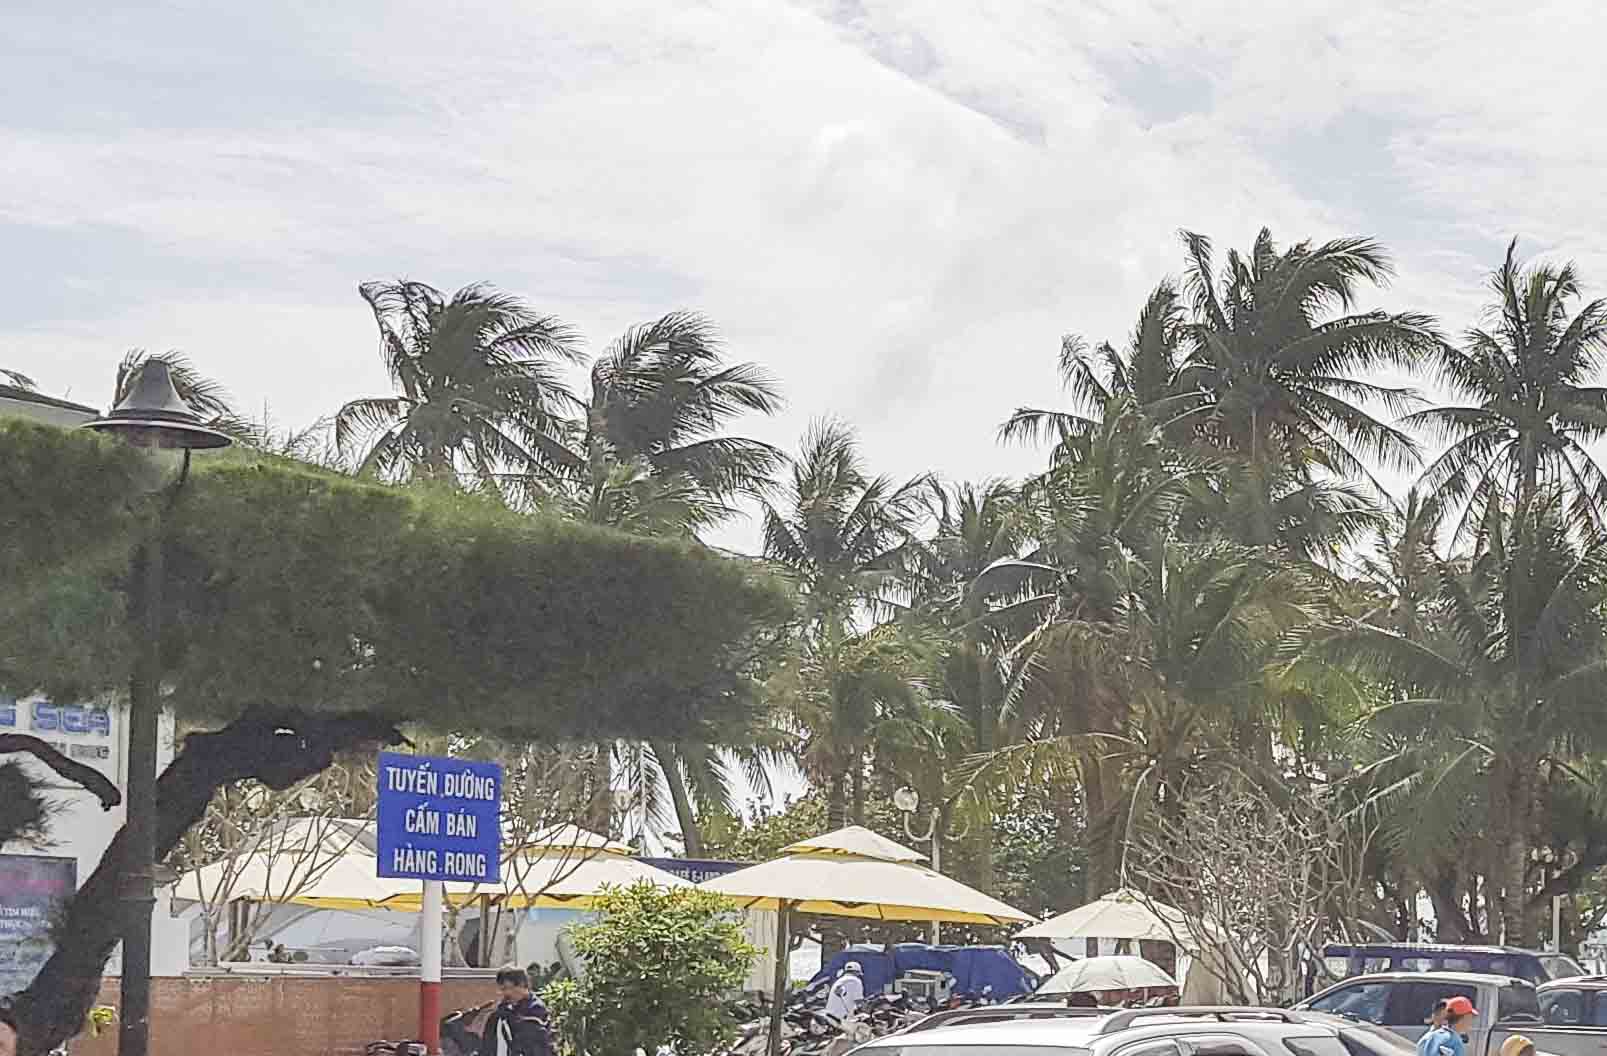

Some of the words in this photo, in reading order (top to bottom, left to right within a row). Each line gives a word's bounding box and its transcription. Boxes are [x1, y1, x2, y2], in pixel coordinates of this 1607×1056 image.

[385, 762, 437, 795] TUYẾN
[444, 769, 495, 801] ĐƯỜNG
[405, 802, 440, 834] CẤM
[446, 808, 477, 837] BÁN
[393, 843, 437, 874] HÀNG
[444, 851, 487, 877] RONG
